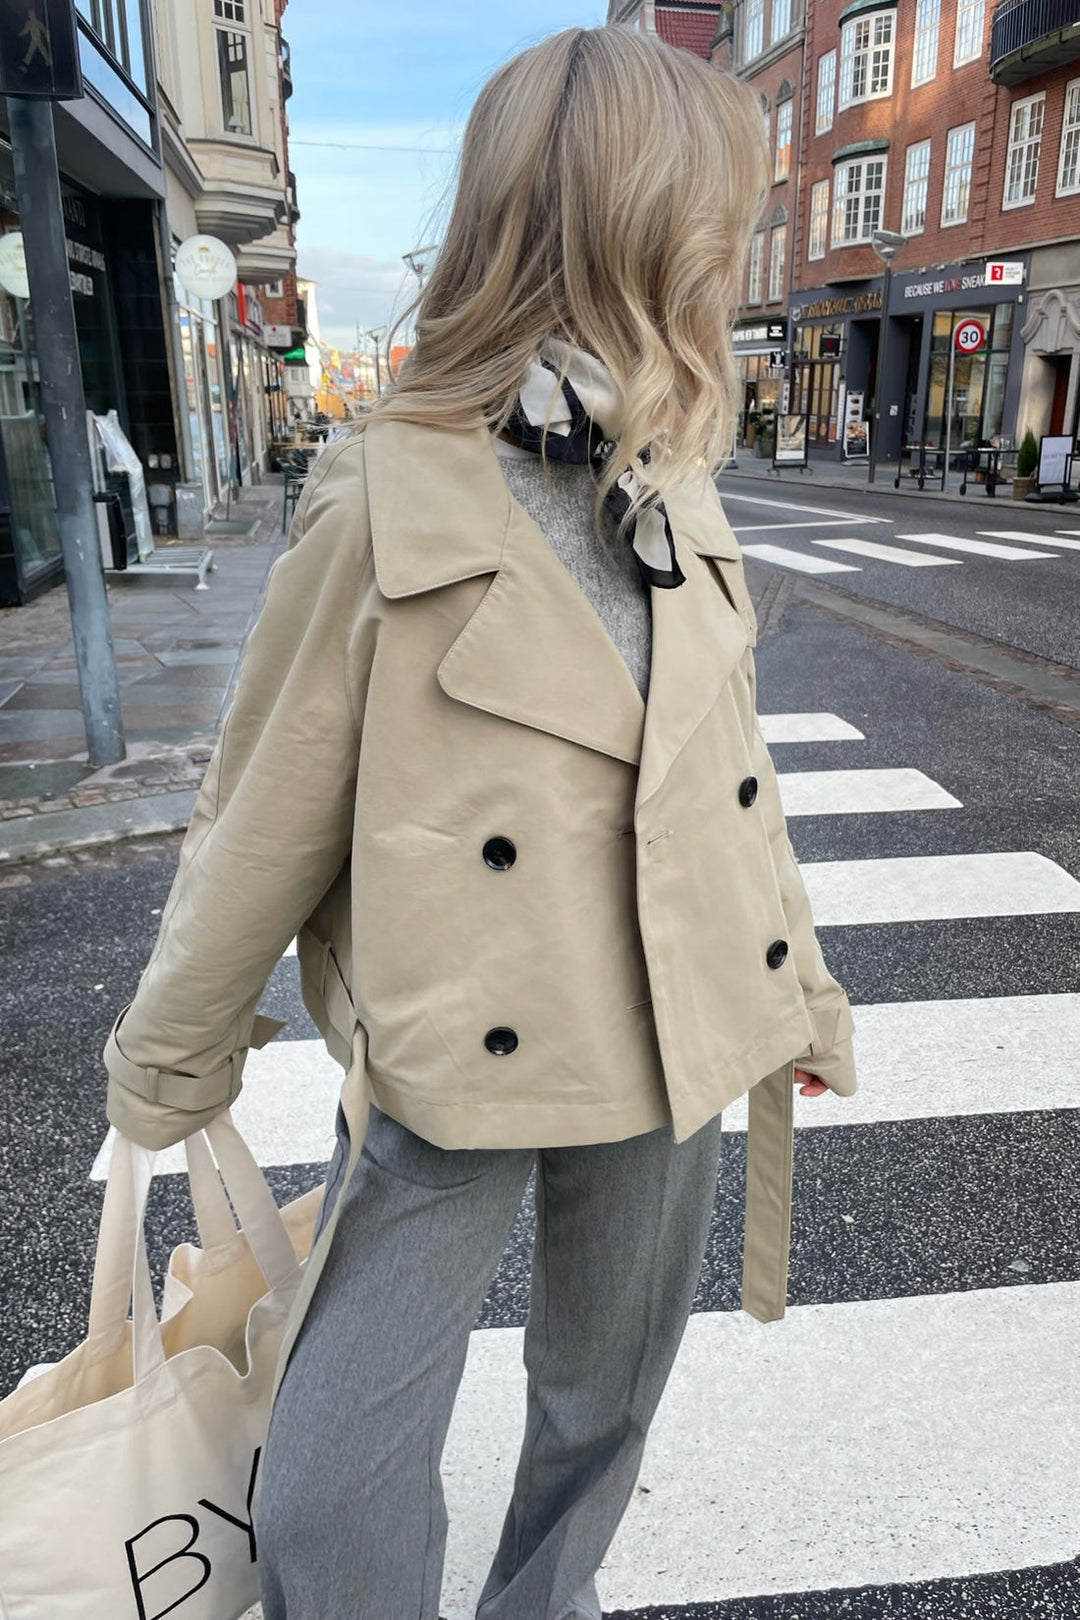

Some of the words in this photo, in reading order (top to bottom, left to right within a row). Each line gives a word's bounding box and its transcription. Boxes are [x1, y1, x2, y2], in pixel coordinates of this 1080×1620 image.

[904, 283, 932, 298] BECAUSE
[933, 281, 944, 293] WE
[961, 331, 979, 344] 30
[125, 1446, 262, 1620] BY
